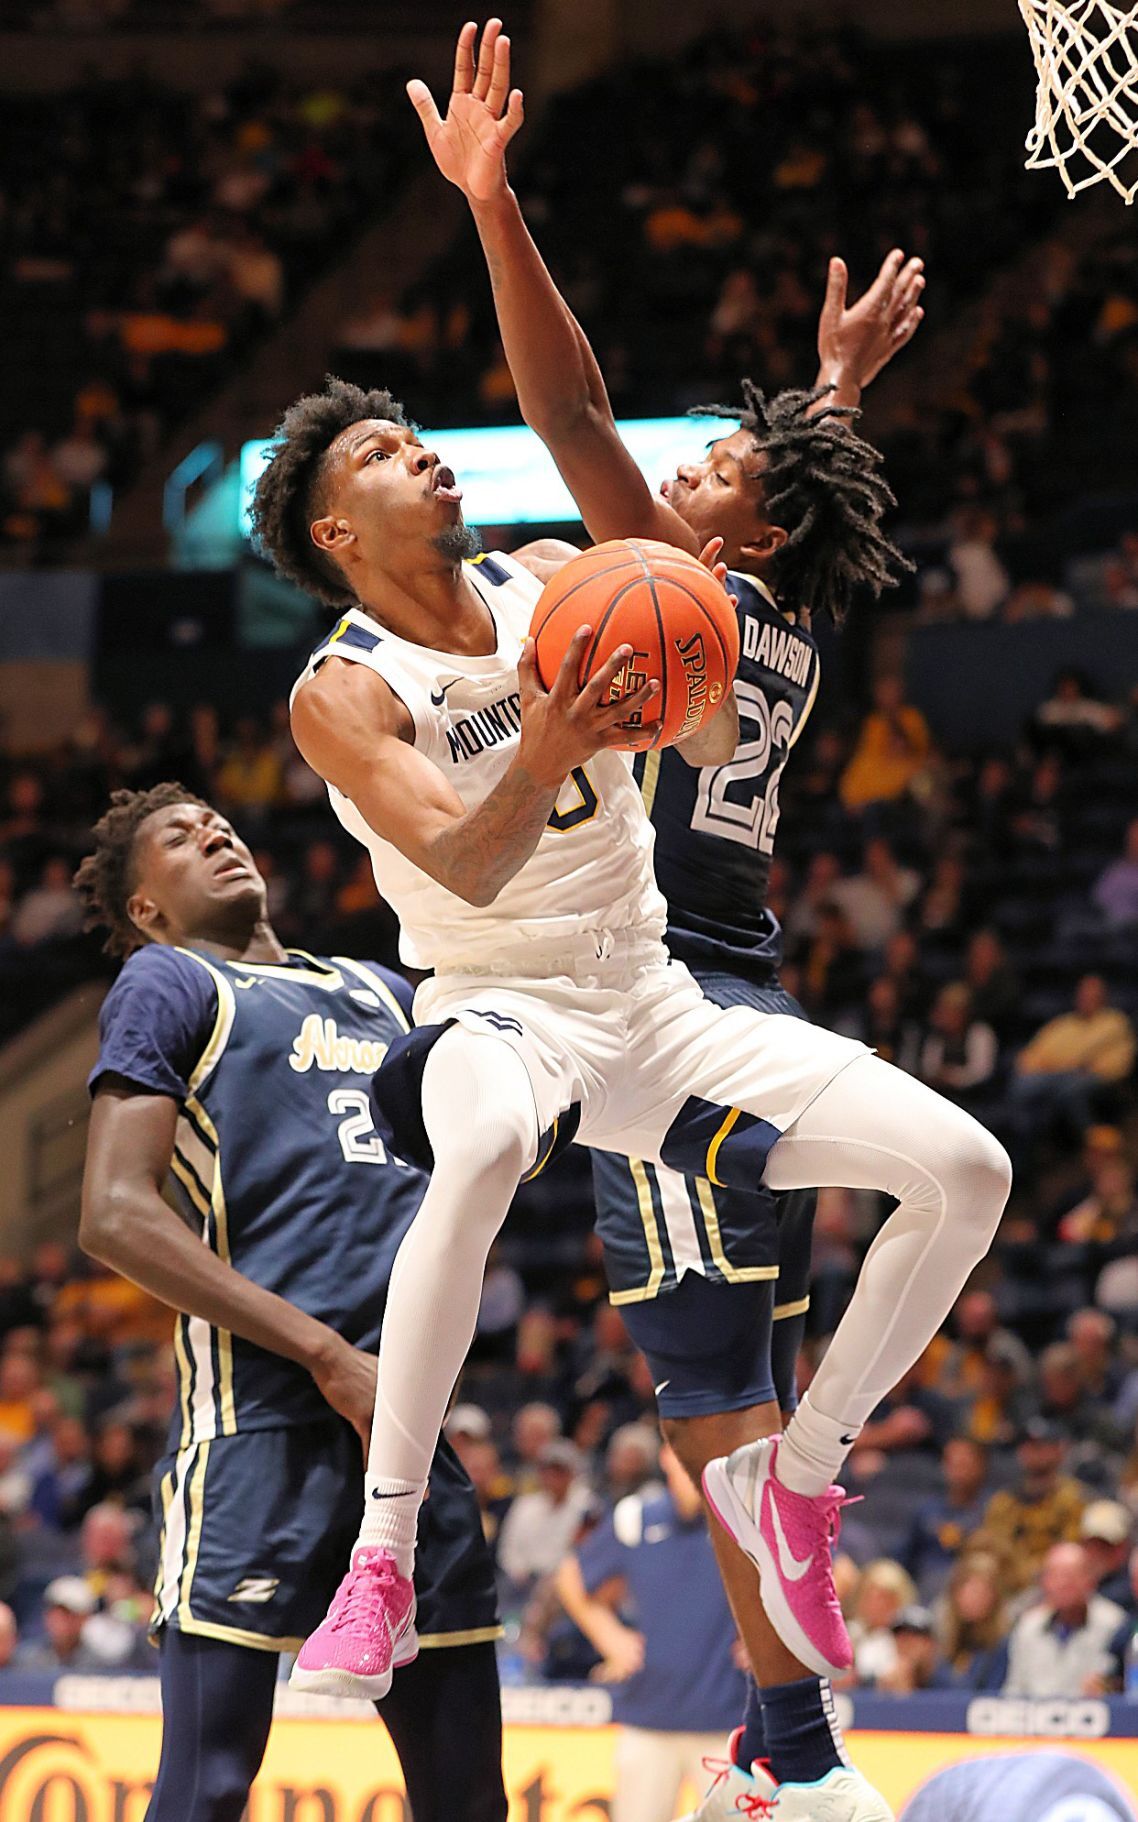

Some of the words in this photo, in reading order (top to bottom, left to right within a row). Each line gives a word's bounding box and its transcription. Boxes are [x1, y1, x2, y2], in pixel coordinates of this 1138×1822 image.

[673, 631, 707, 740] SPALDIN
[742, 614, 813, 688] DAWSON
[288, 1013, 389, 1075] Akro
[327, 1088, 410, 1166] 2
